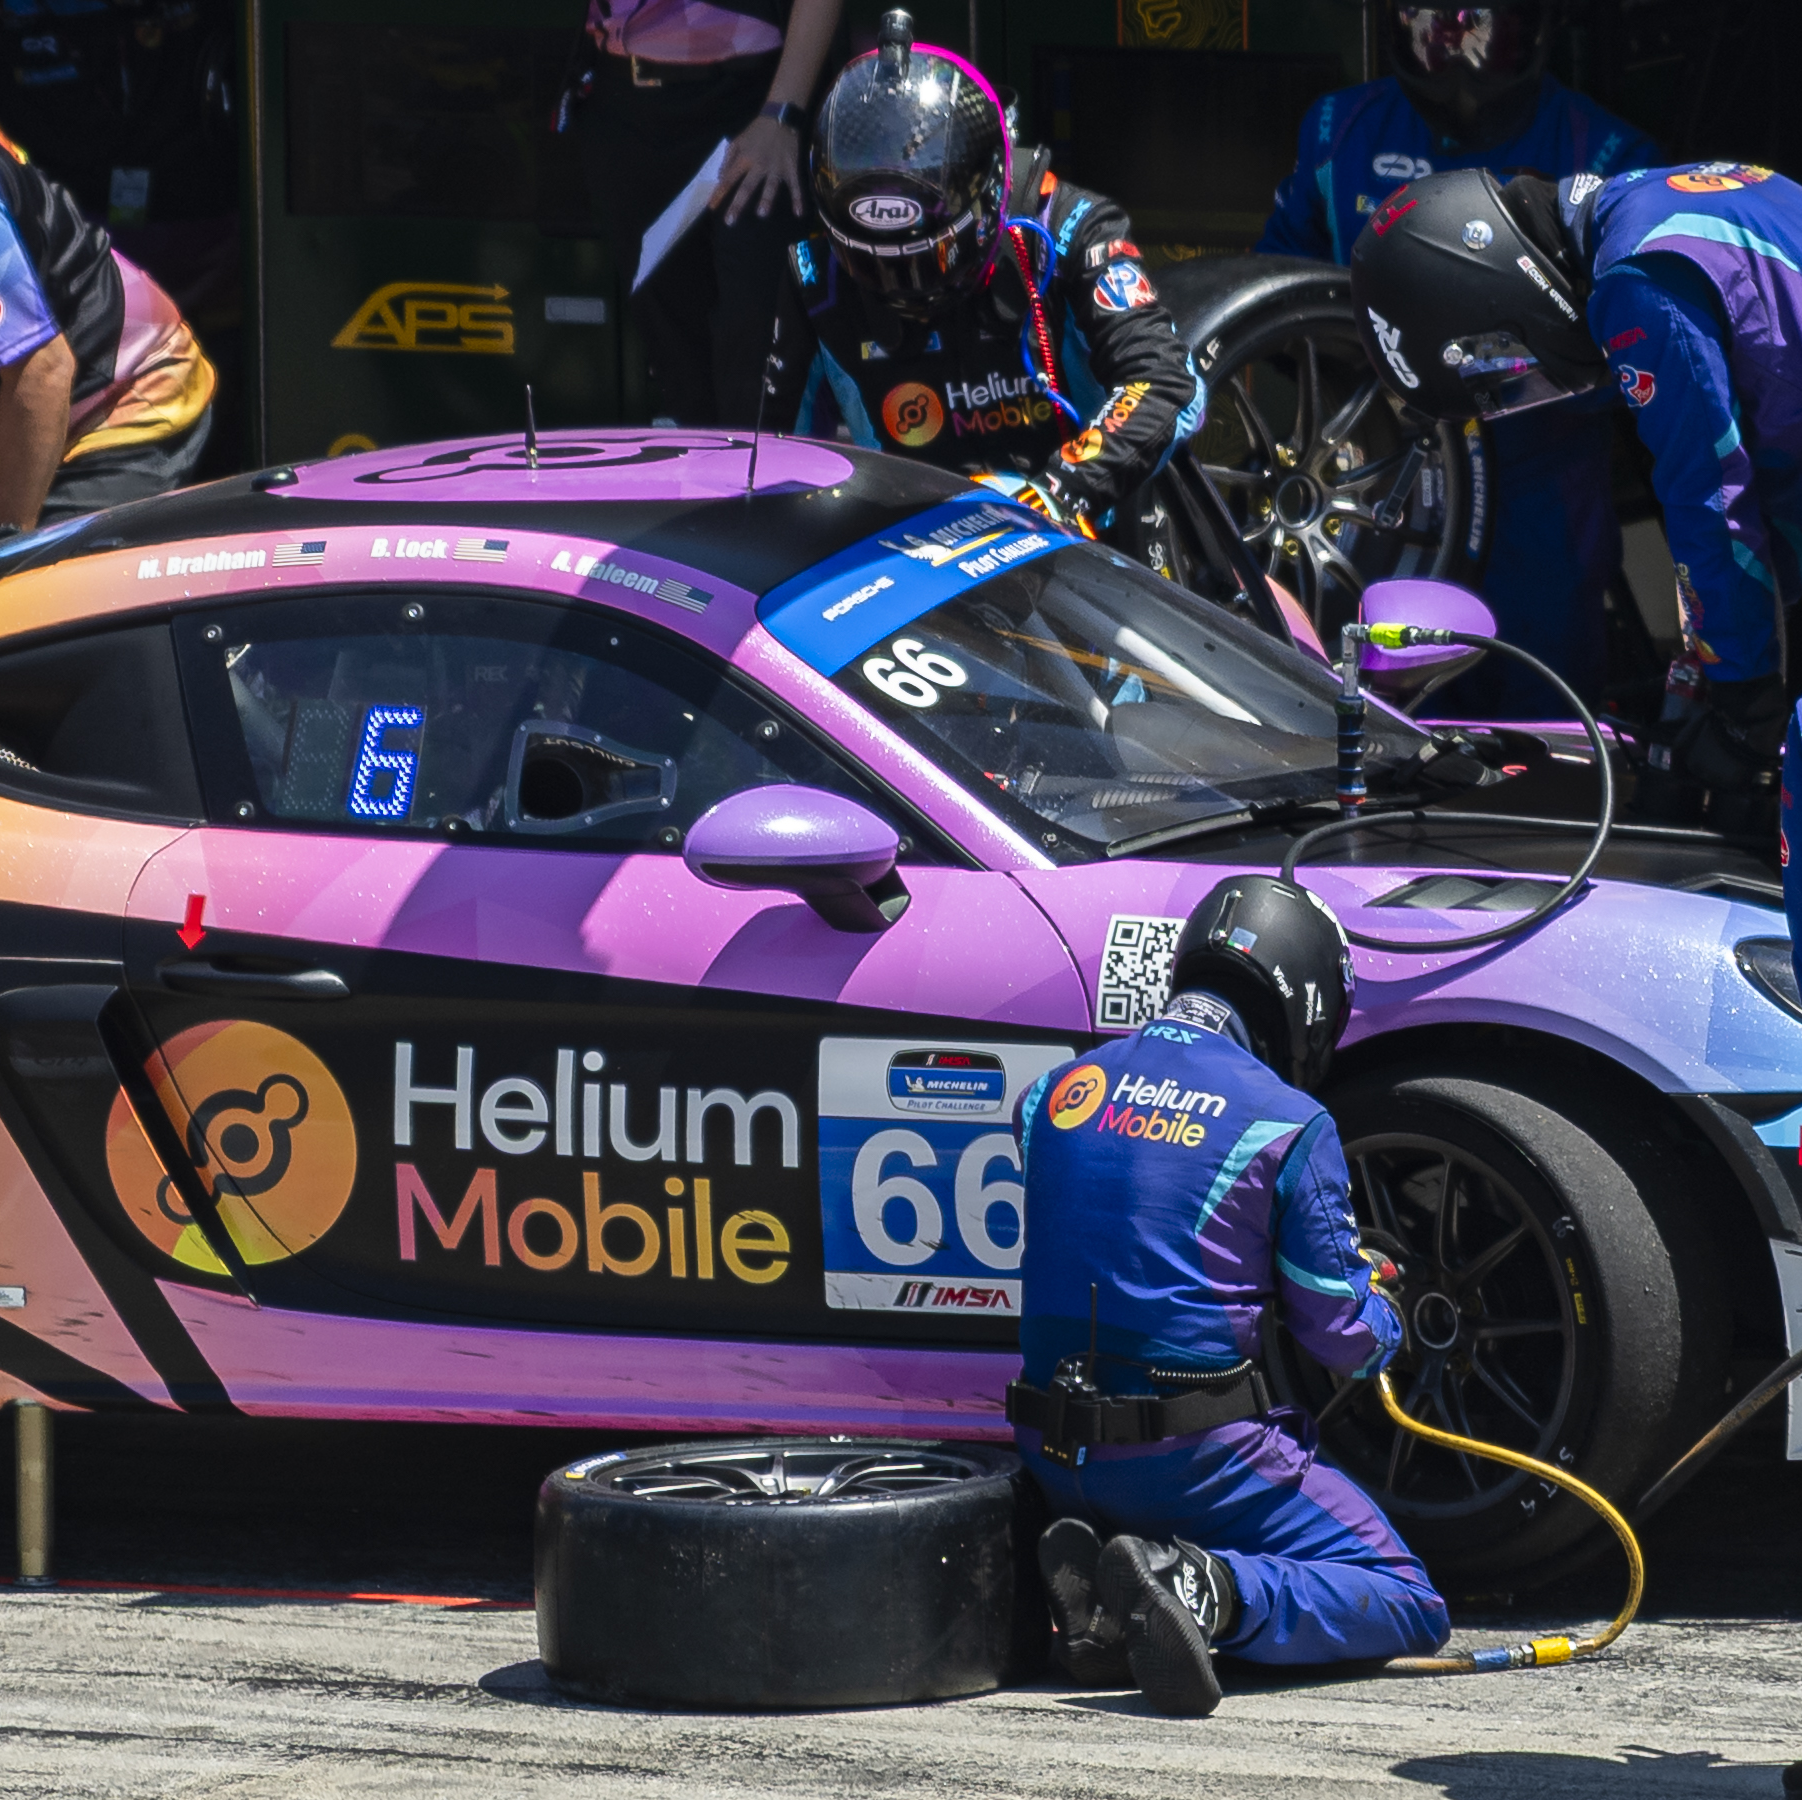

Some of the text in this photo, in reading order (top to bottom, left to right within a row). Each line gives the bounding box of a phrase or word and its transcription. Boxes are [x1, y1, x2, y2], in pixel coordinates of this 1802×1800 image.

[855, 200, 912, 219] Arai
[136, 547, 267, 580] M. Brabham
[370, 538, 449, 560] B. Lock
[821, 575, 895, 622] PORSCHE
[862, 637, 968, 708] 66
[347, 704, 424, 818] 6
[1272, 964, 1295, 1000] Virgil
[1142, 1025, 1204, 1046] HRX
[393, 1040, 800, 1169] Helium
[926, 1080, 989, 1092] MICHELIN
[1111, 1072, 1228, 1119] Helium
[1096, 1103, 1206, 1148] Mobile
[850, 1128, 1026, 1271] 66
[396, 1162, 793, 1286] Mobile
[930, 1286, 1014, 1309] IMSA
